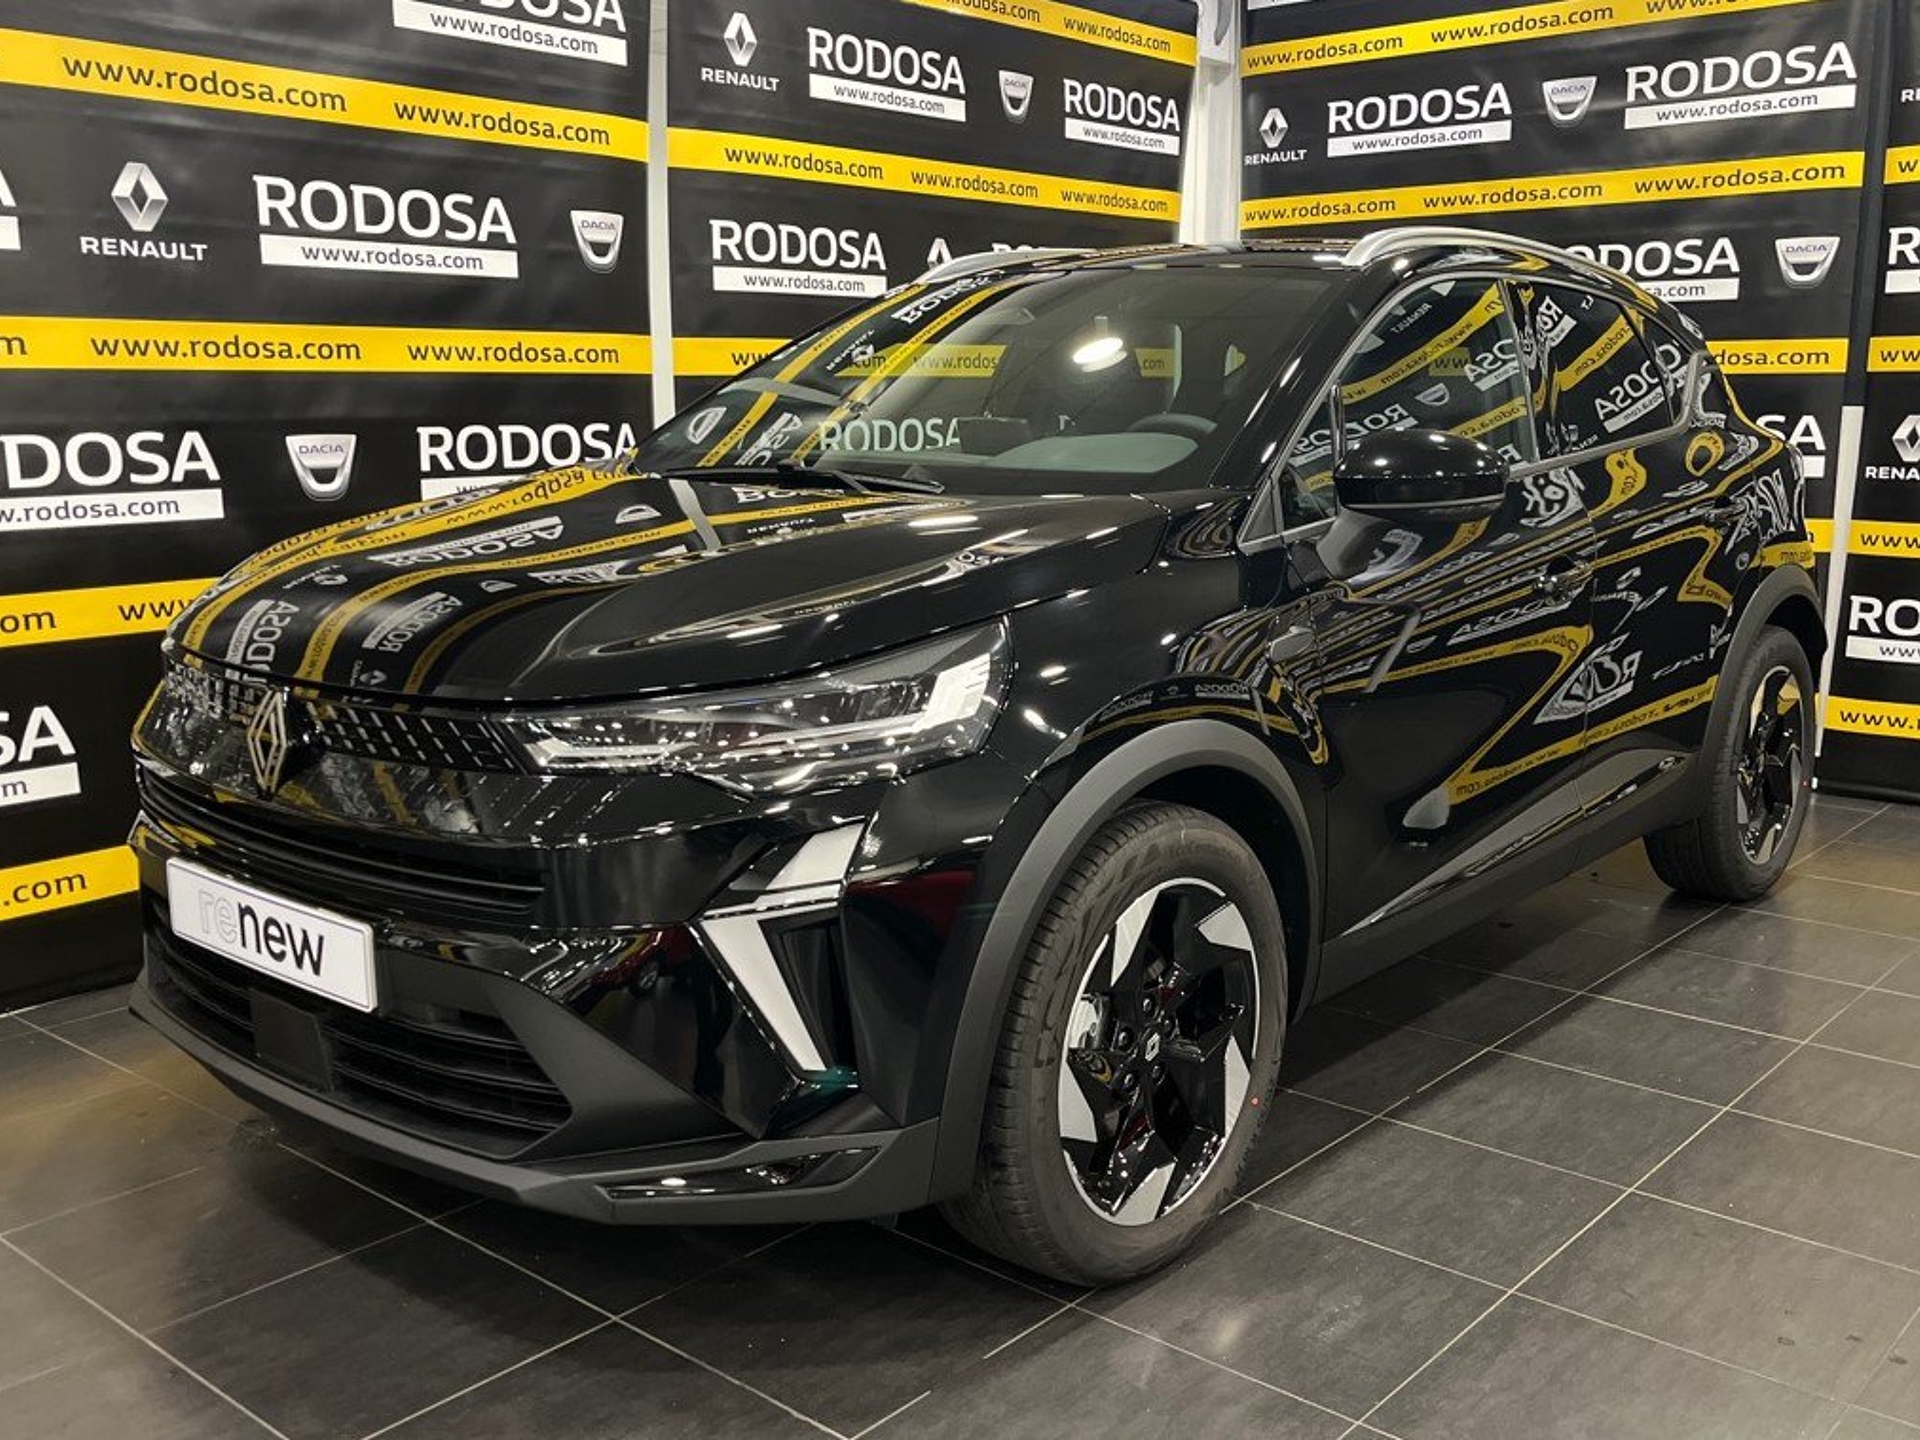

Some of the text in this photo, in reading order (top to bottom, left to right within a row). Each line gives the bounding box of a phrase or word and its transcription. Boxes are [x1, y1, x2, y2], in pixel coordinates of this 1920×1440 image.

[430, 12, 599, 54] www.rodosa.com
[1063, 16, 1171, 53] www.rodosa.com
[1247, 8, 1614, 69] www.rodosa.com www.rodosa.com
[701, 67, 780, 92] RENAULT
[806, 27, 967, 95] RODOSA
[1625, 41, 1858, 103] RODOSA
[62, 56, 611, 146] www.rodosa.com www.rodosa.com
[833, 83, 946, 114] www.rodosa.com
[1063, 78, 1181, 132] RODOSA
[1326, 82, 1513, 134] RODOSA
[1656, 93, 1819, 122] www.rodosa.com
[1082, 125, 1166, 149] www.rodosa.com
[1244, 149, 1308, 166] RENAULT
[1352, 126, 1483, 152] www.rodosa.com
[725, 147, 1169, 214] www.rodosa.com www.rodosa.com www.rodosa.com
[1245, 163, 1846, 222] www.rodosa.com www.rodosa.com www.rodosa.com
[252, 174, 518, 245] RODOSA
[79, 235, 209, 262] RENAULT
[301, 244, 485, 271] www.rodosa.com
[709, 218, 887, 271] RODOSA
[743, 274, 866, 293] www.rodosa.com
[90, 334, 620, 364] www.rodosa.com www.rodosa.com
[299, 443, 346, 455] DACIA
[416, 422, 637, 473] RODOSA
[198, 887, 325, 977] renew
